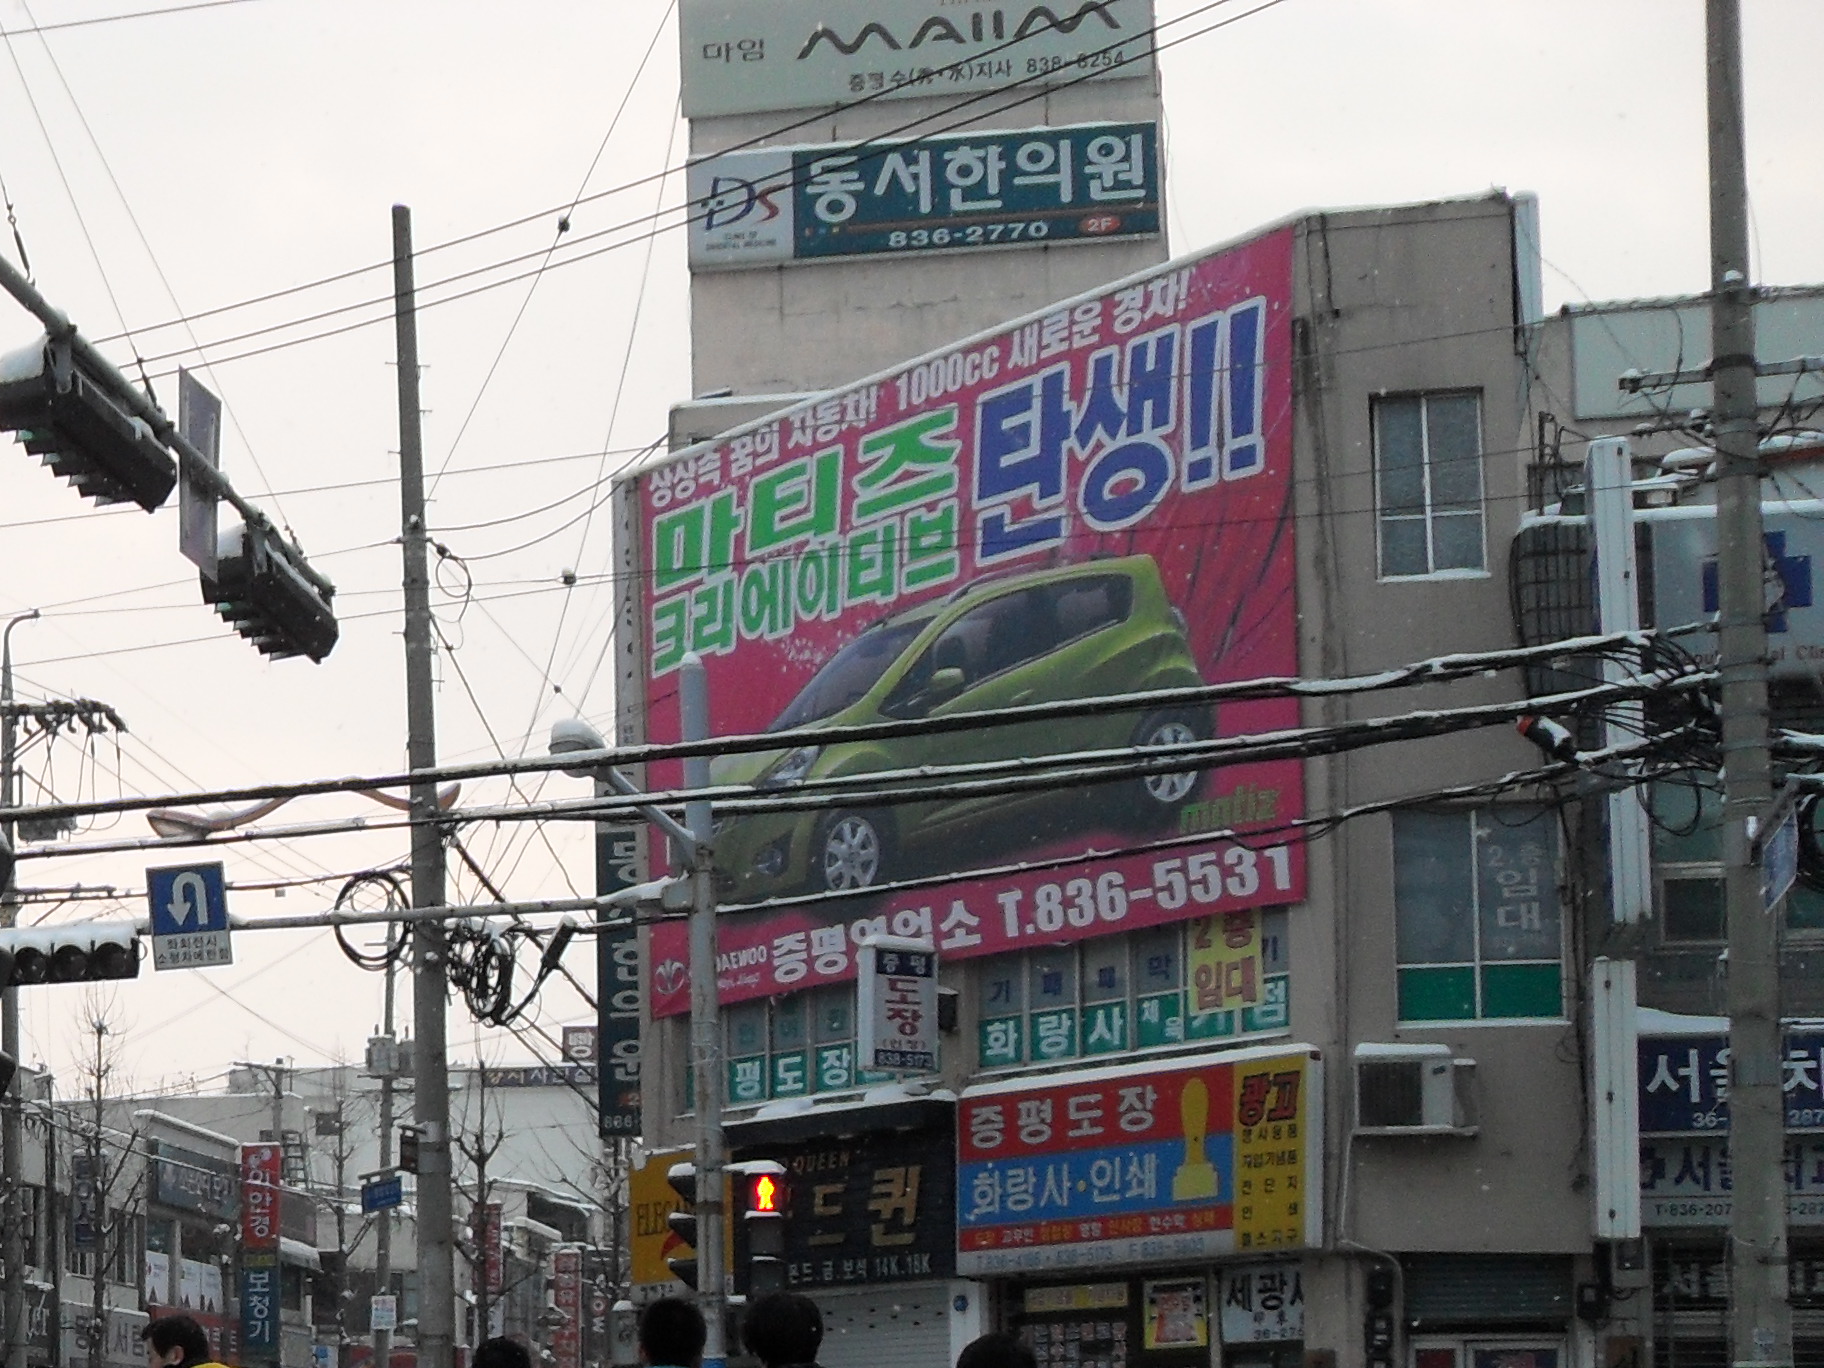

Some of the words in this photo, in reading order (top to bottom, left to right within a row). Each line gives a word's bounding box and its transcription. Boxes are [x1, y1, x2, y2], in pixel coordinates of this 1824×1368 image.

[702, 38, 765, 62] 마임
[806, 134, 1147, 226] 동서한의원
[888, 221, 1050, 249] 836-2770
[1088, 216, 1115, 233] 2F
[649, 453, 722, 508] 상상속
[729, 421, 780, 478] 꿈의
[1008, 302, 1102, 370] 새로운
[1112, 270, 1192, 334] 경차!
[651, 401, 962, 597] 마티즈
[971, 294, 1267, 568] 탄생!!
[651, 495, 962, 680] 크리에이티브
[997, 844, 1293, 939] T.836-5531
[885, 977, 923, 1036] 도장
[1194, 954, 1257, 1012] 임대
[971, 1084, 1158, 1149] 증평도장
[1239, 1071, 1300, 1127] 광고
[793, 1151, 851, 1174] QUEEN
